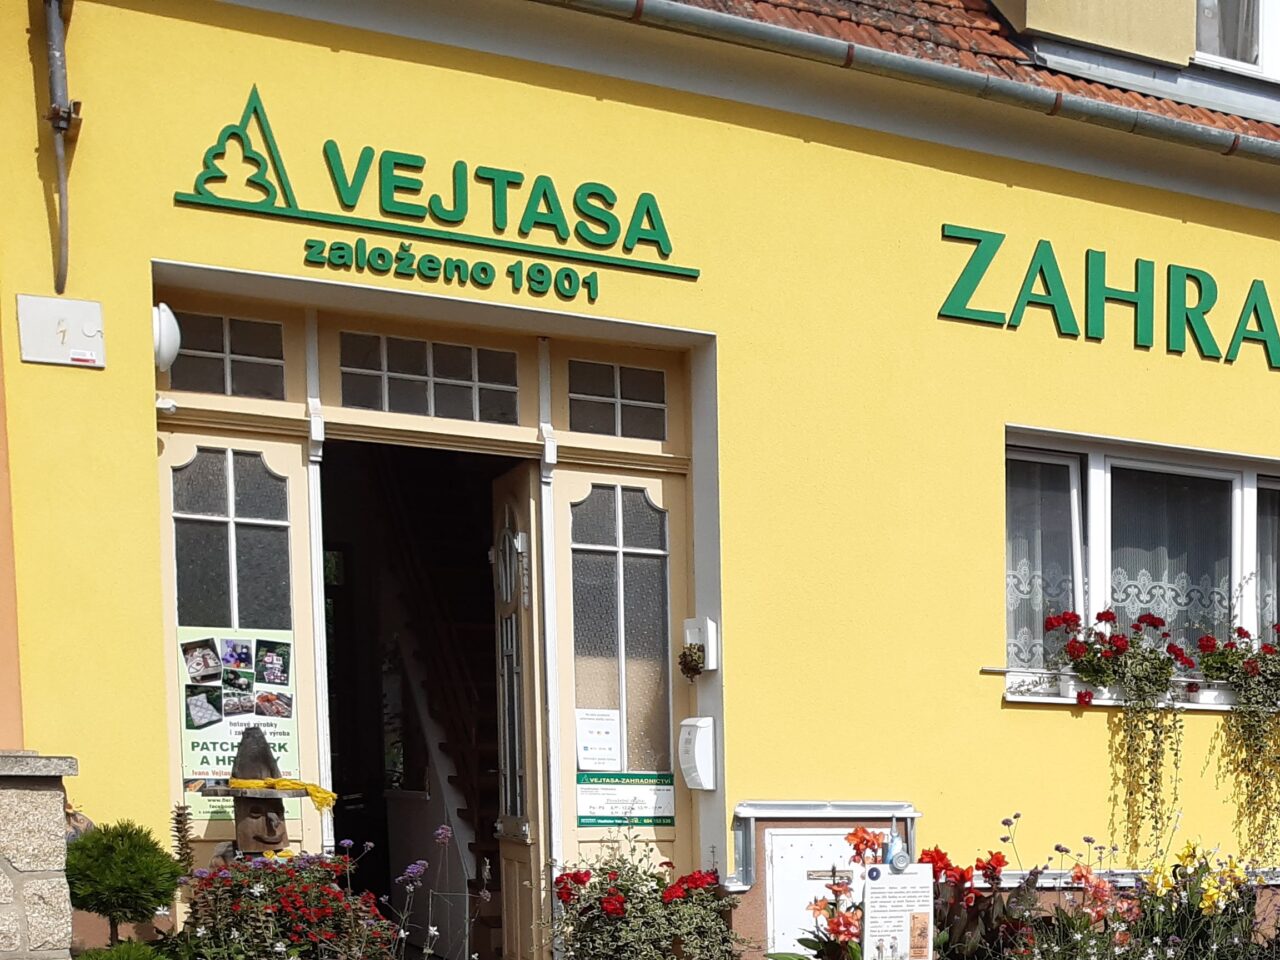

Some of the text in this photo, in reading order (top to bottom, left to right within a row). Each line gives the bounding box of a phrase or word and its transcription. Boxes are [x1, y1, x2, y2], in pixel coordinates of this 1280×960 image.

[323, 138, 674, 256] VEJTASA
[303, 237, 600, 301] založeno 1901
[253, 721, 277, 729] výrobky
[191, 741, 289, 752] PATCHRK
[200, 755, 211, 765] A
